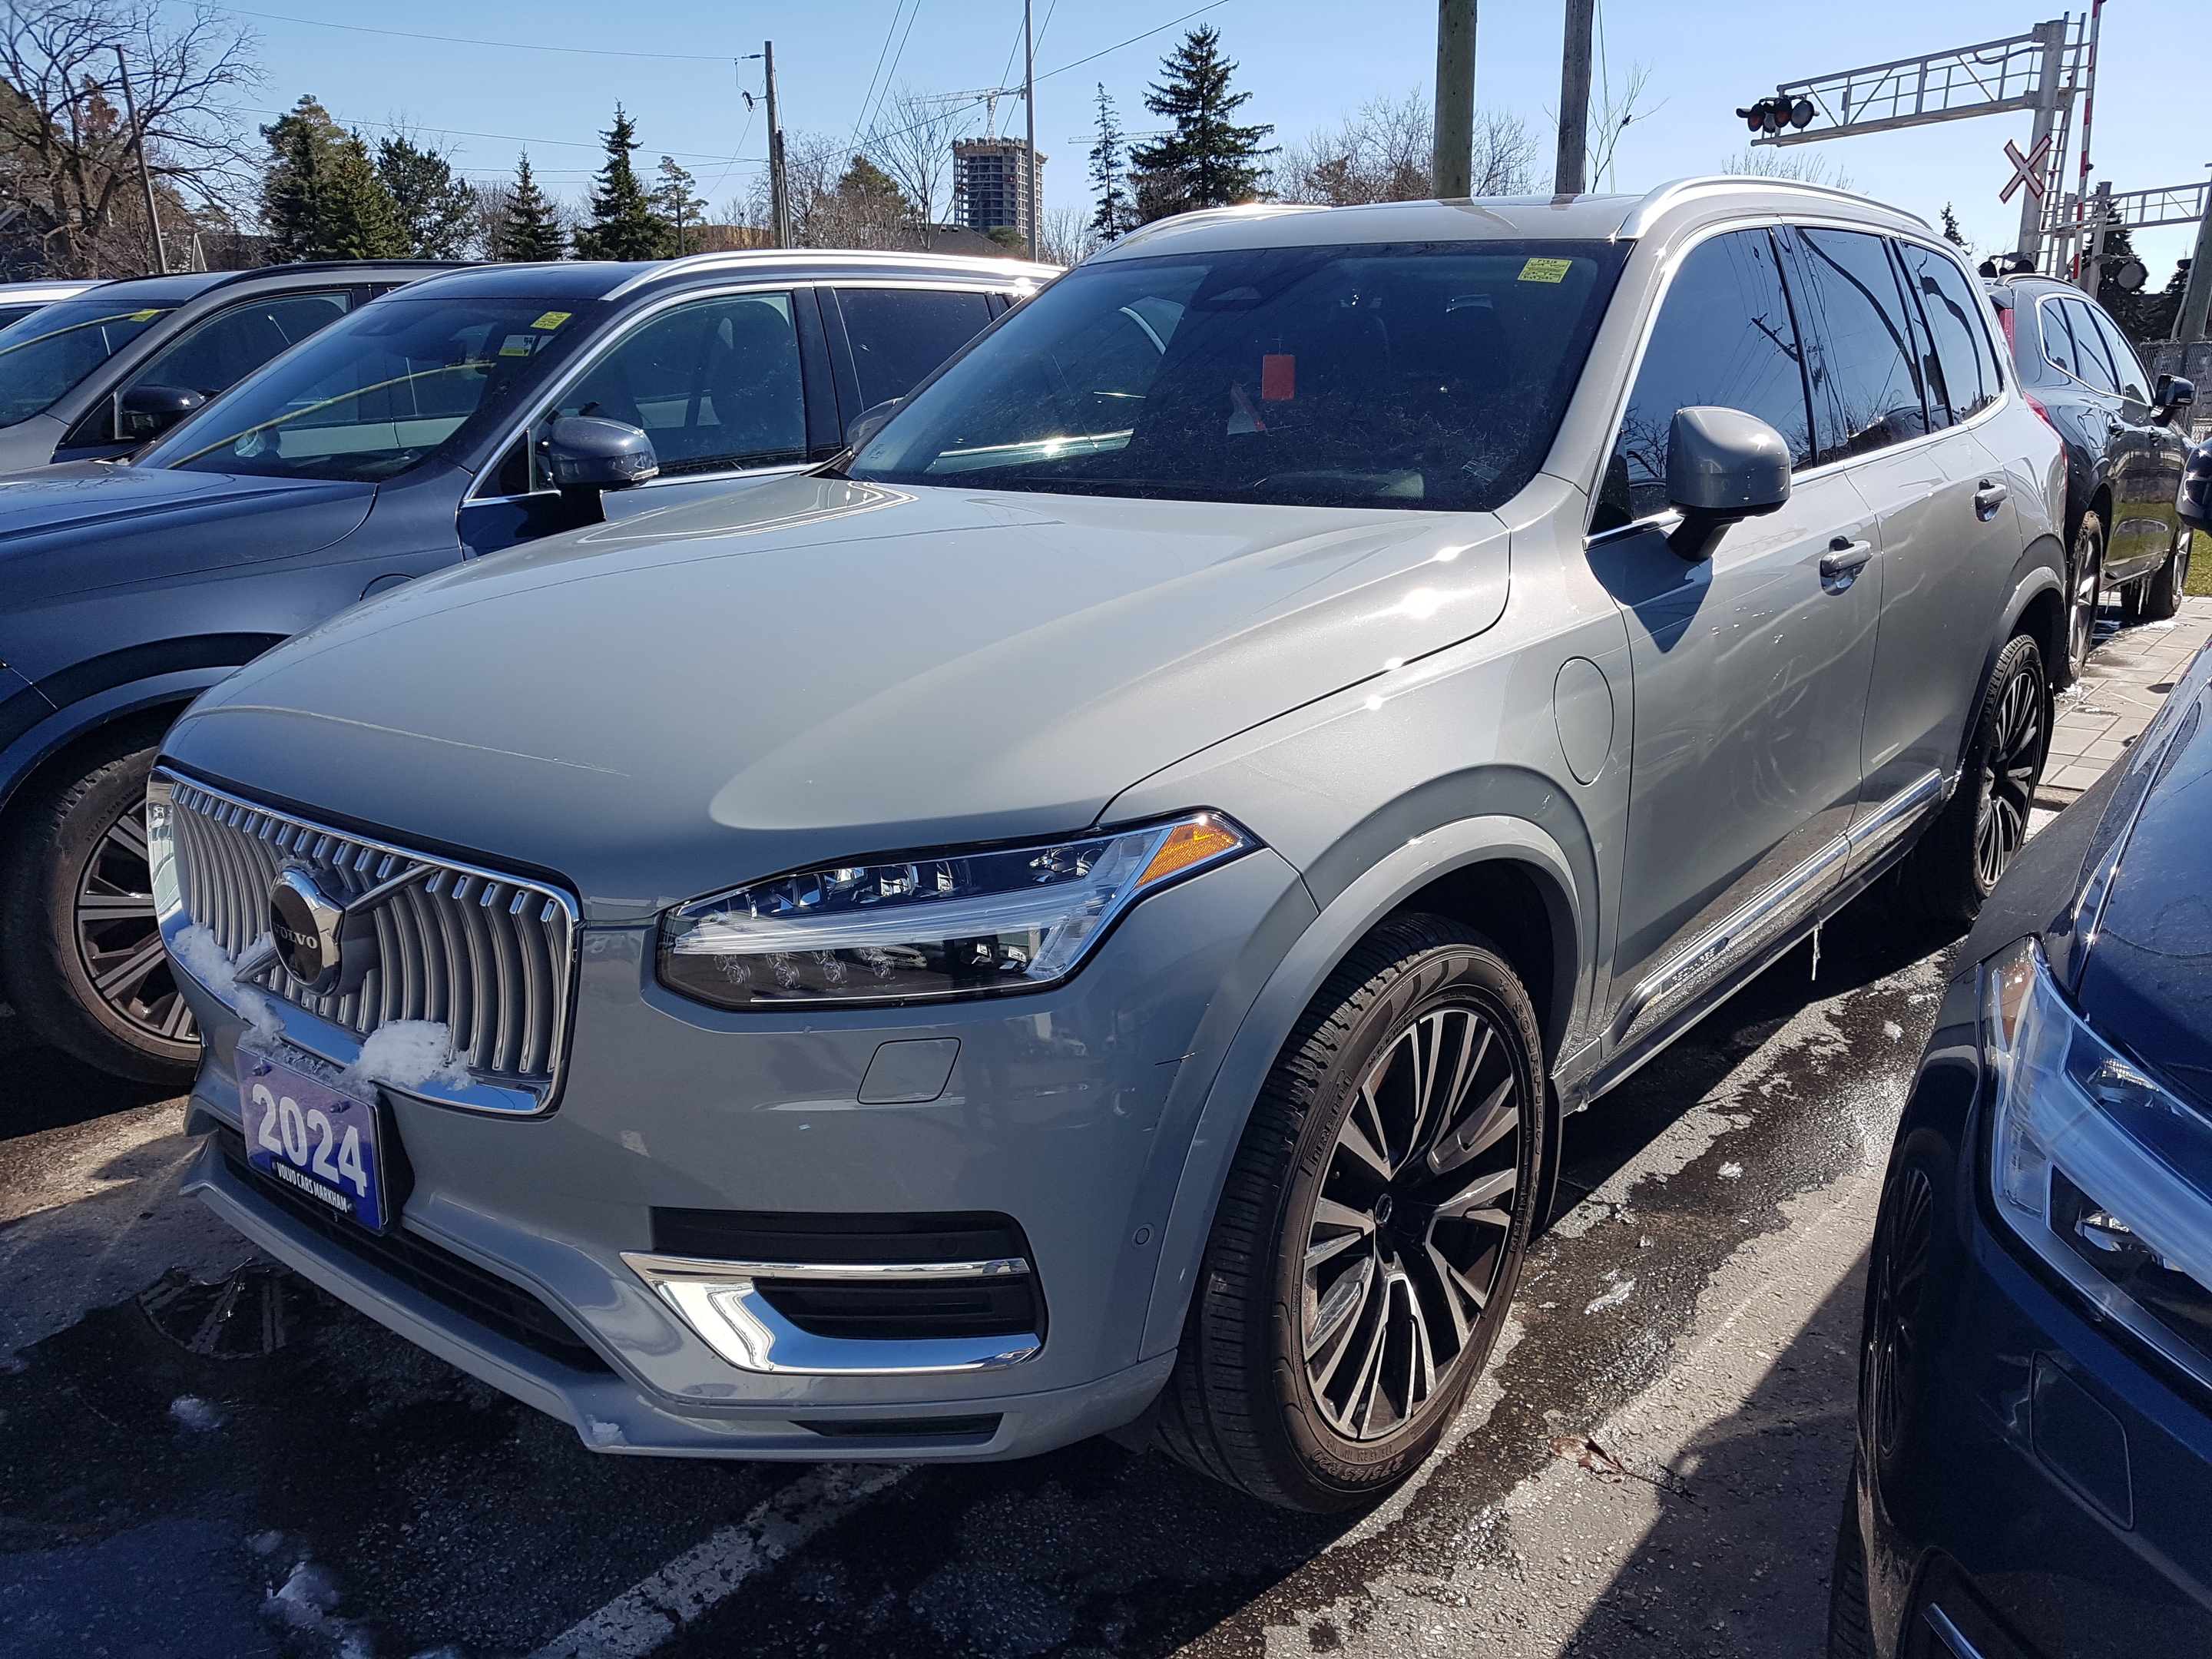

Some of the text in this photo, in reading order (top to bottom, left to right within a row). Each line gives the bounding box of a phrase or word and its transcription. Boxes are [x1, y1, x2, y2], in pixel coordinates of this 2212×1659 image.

[272, 922, 318, 949] VOLVO
[1512, 998, 1543, 1155] SCORPION
[252, 1083, 367, 1198] 2024
[276, 1161, 348, 1214] VOLVO CARS MARKHAM
[1311, 1448, 1343, 1476] R20
[1340, 1453, 1406, 1482] 275/45
